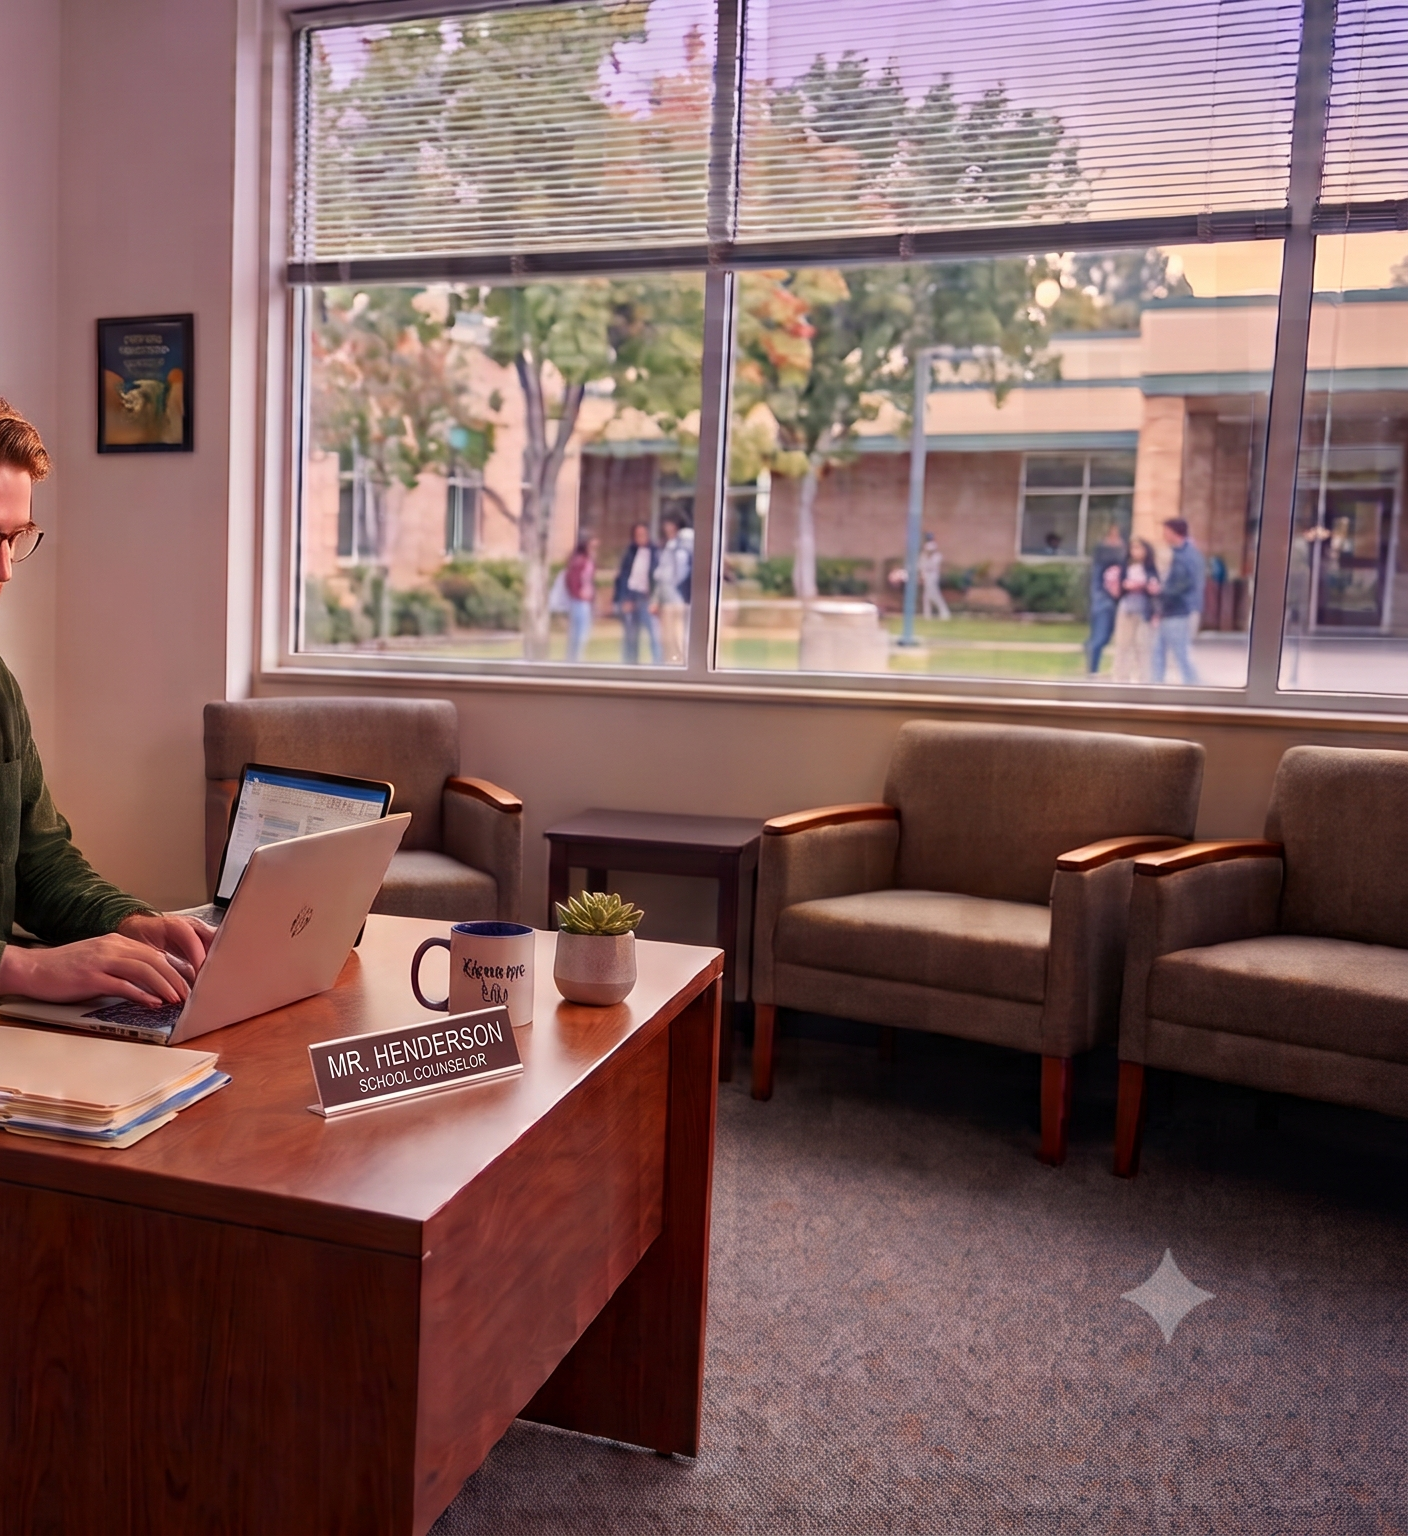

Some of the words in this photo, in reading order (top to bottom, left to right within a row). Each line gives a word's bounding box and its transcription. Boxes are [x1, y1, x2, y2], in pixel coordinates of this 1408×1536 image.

[327, 1050, 370, 1079] MR.
[373, 1020, 504, 1070] HENDERSON
[358, 1069, 412, 1093] SCHOOL
[413, 1052, 488, 1081] COUNSELOR
